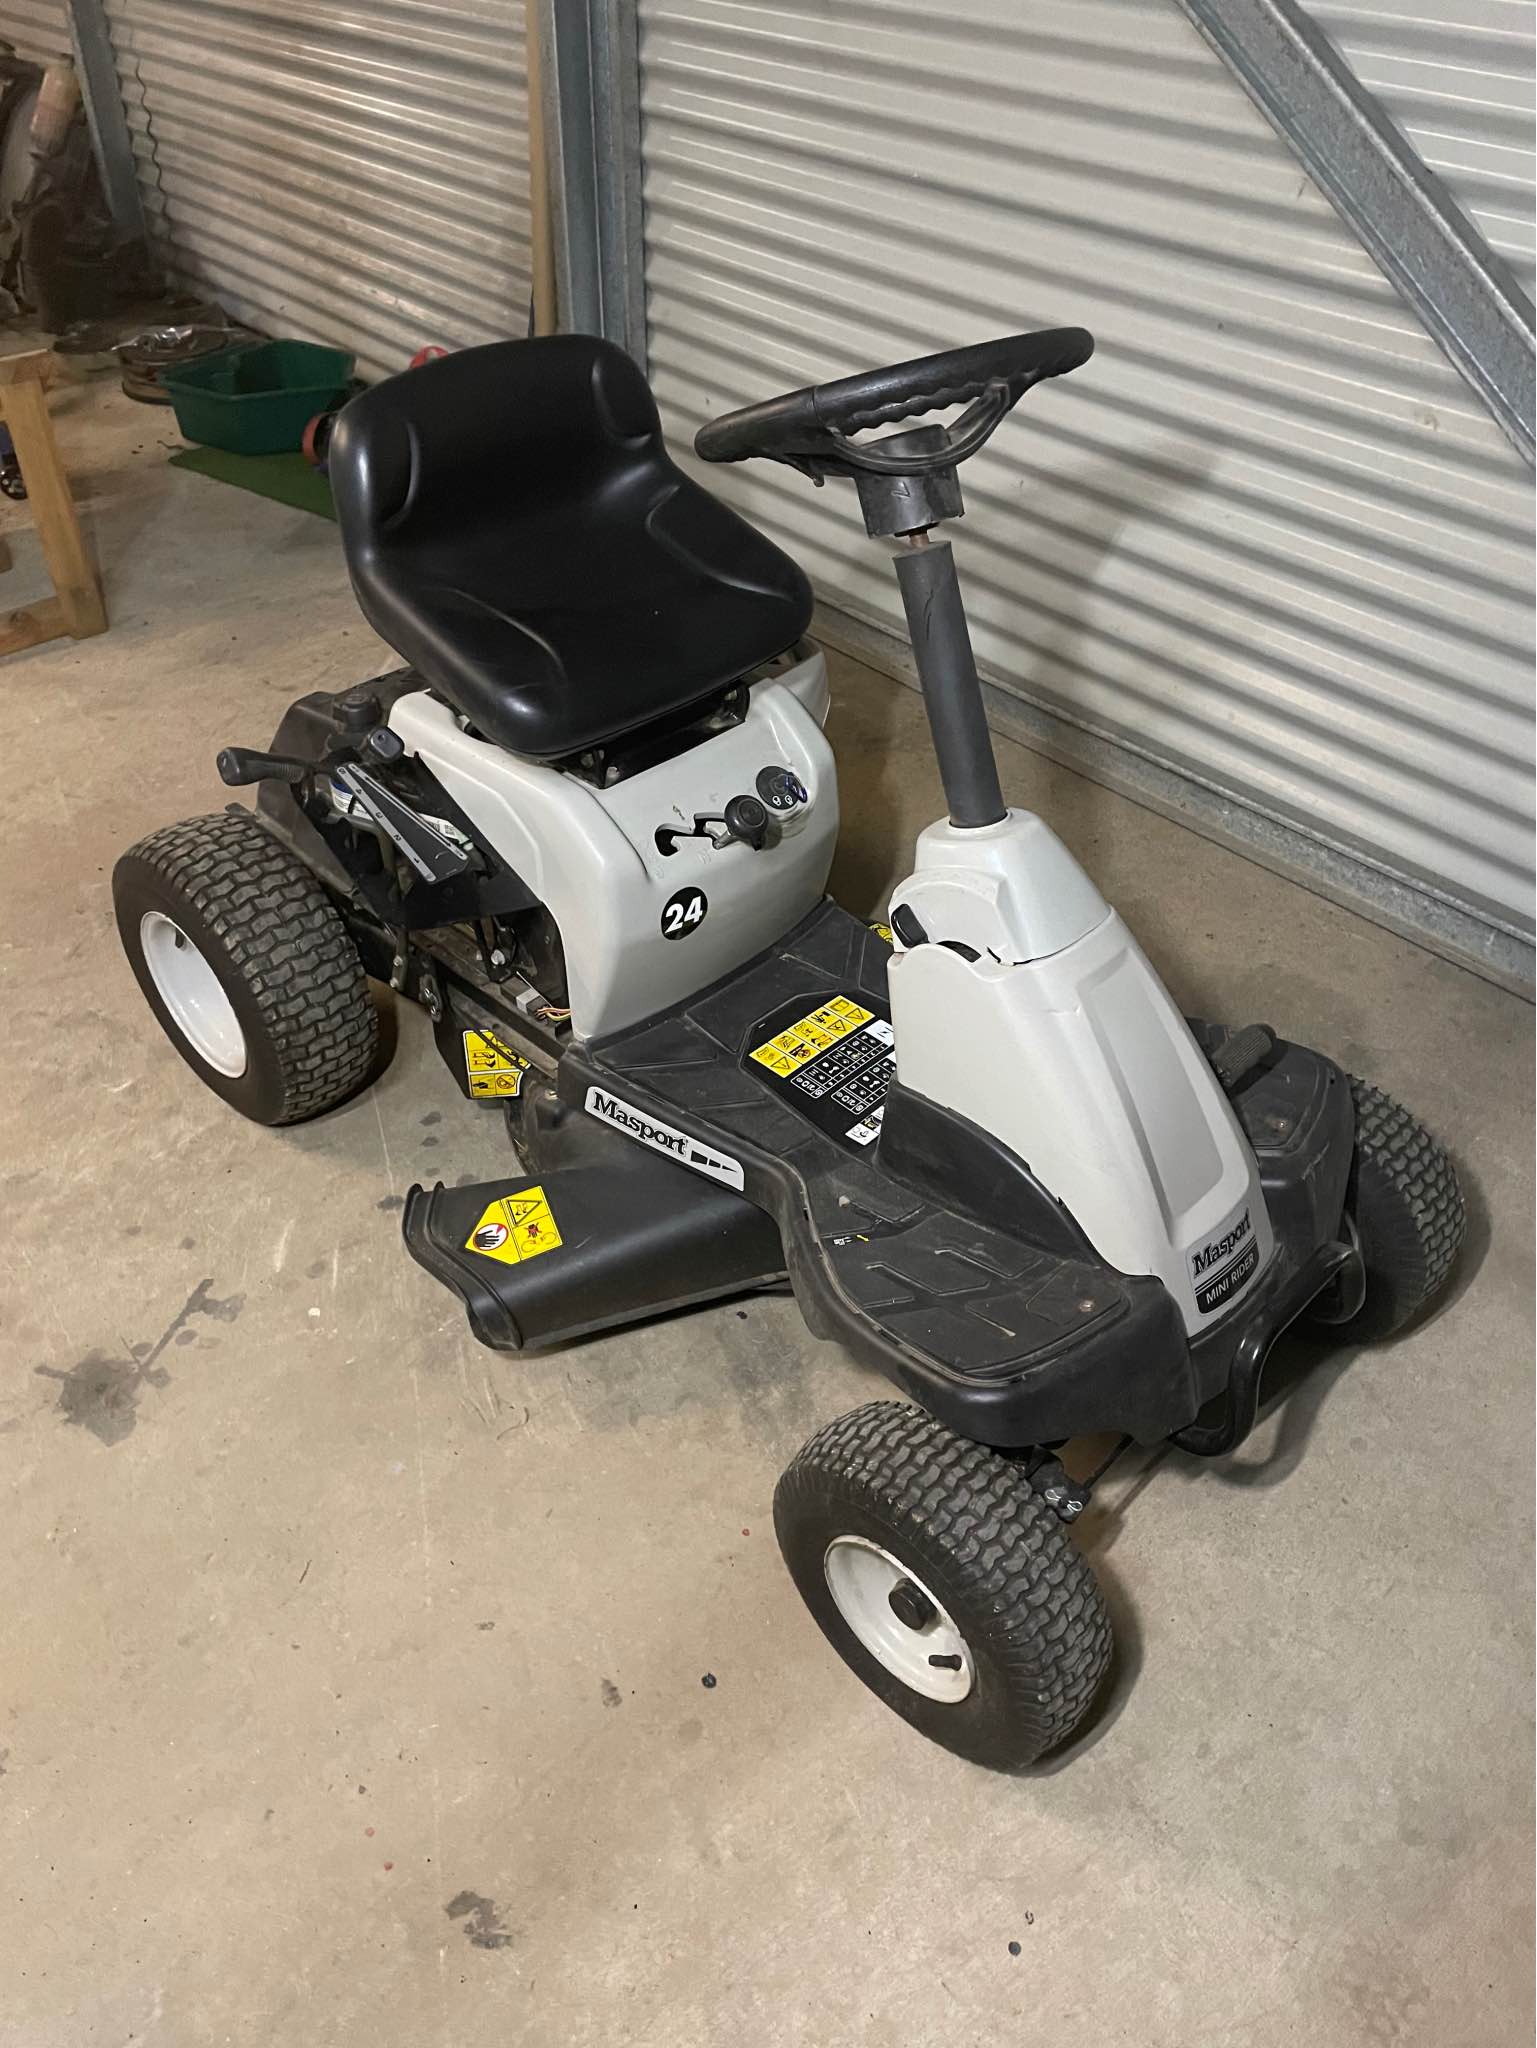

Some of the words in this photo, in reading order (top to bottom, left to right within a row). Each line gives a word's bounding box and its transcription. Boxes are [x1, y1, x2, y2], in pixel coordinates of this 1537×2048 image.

[375, 811, 383, 819] 3
[664, 895, 703, 934] 24
[593, 1091, 687, 1155] Masport
[1192, 1207, 1251, 1276] Masport
[1205, 1280, 1230, 1305] MINI
[1231, 1252, 1255, 1282] RIDER
